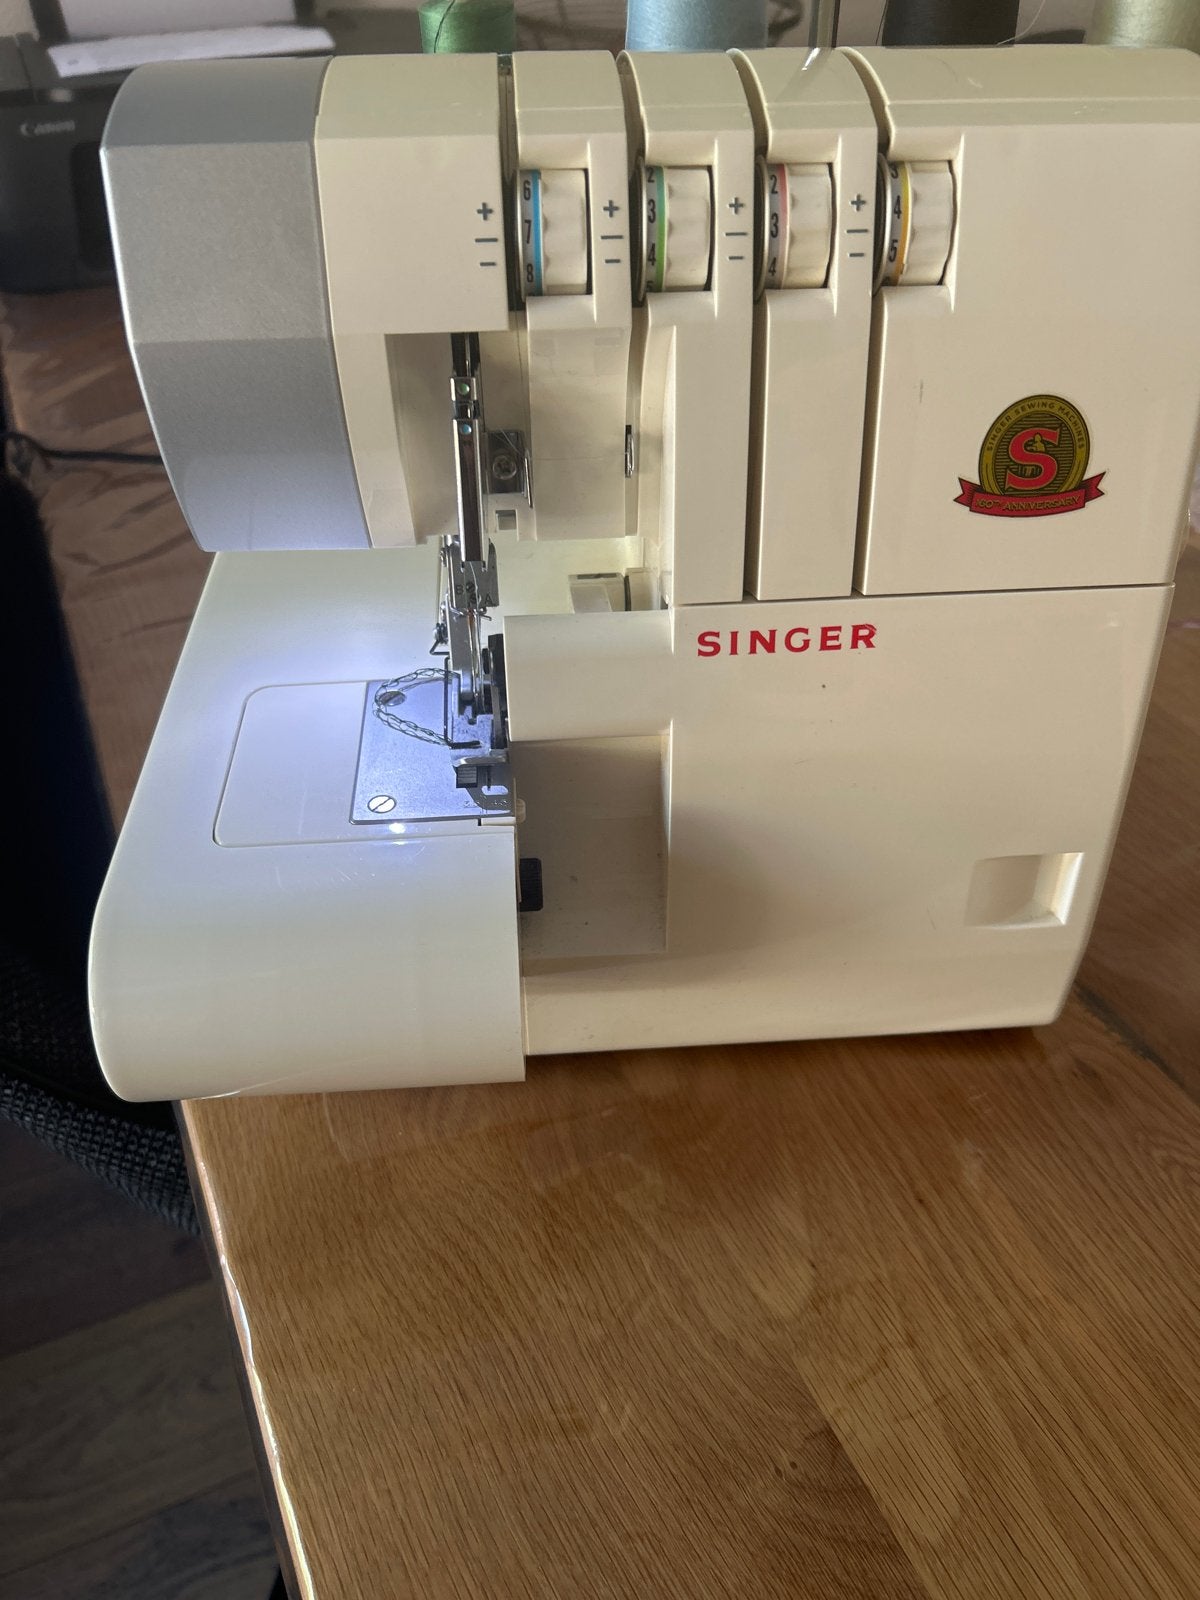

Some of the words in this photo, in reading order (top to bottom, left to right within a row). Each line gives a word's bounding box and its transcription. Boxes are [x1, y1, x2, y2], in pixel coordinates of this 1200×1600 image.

[523, 180, 531, 201] 6
[770, 174, 778, 194] 2
[647, 198, 656, 223] 3
[893, 194, 902, 219] 4
[524, 219, 532, 244] 7
[770, 212, 779, 238] 3
[647, 242, 656, 266] 4
[888, 239, 898, 263] 5
[526, 263, 534, 283] 8
[768, 256, 777, 276] 4
[986, 415, 1012, 452] SINGER
[1014, 401, 1055, 416] SEWING
[1057, 405, 1085, 449] MACHINES
[1002, 495, 1081, 512] ANNIVERSARY
[697, 623, 877, 657] SINGER
